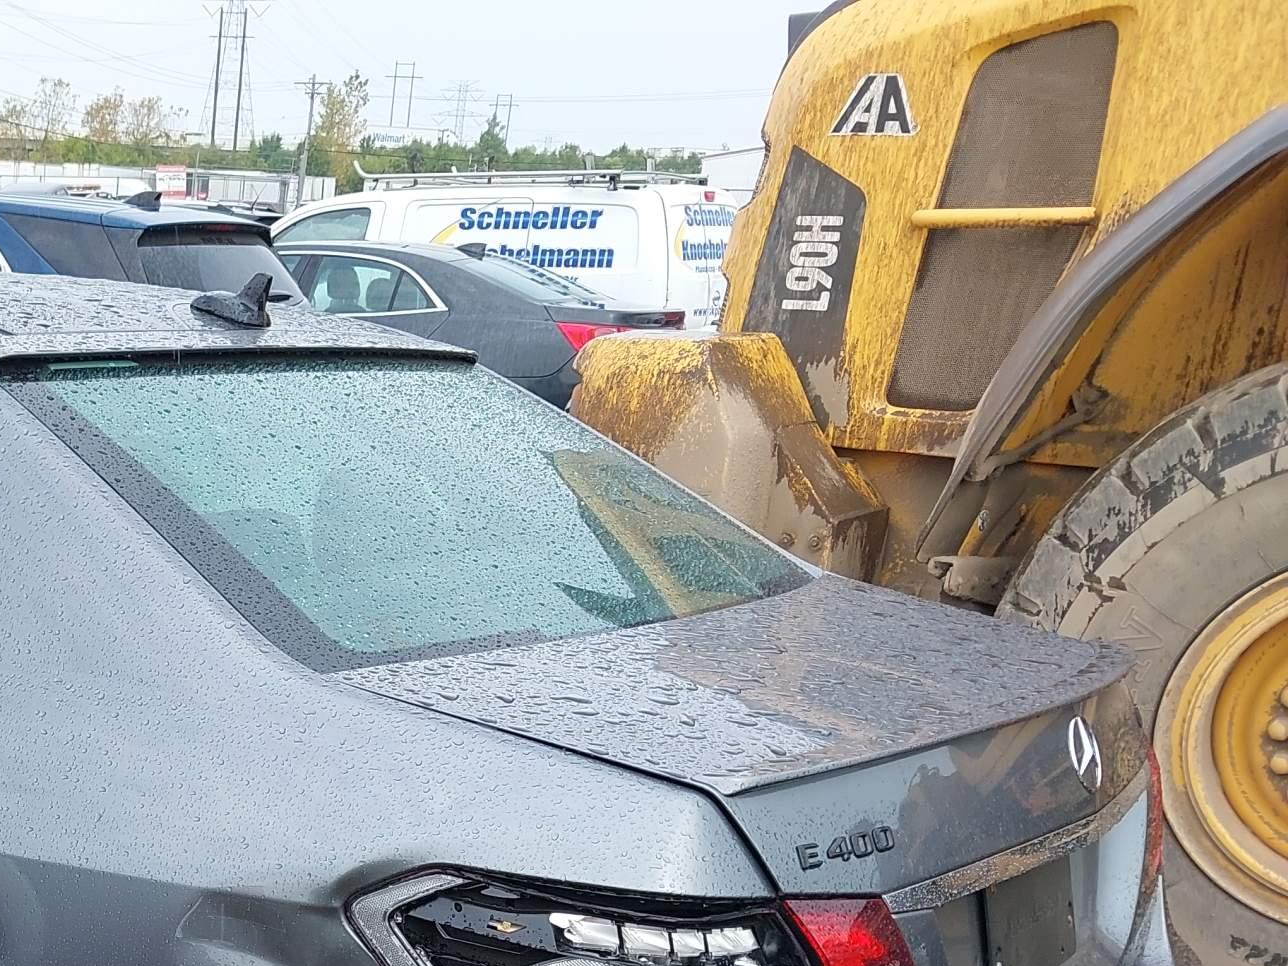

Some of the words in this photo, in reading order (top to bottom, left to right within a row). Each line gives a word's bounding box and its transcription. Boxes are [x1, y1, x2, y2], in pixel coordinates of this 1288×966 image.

[374, 132, 405, 143] Walmart
[459, 206, 604, 230] Schneller
[684, 206, 734, 226] Schnelle
[781, 215, 844, 312] L90H
[796, 843, 823, 871] E
[827, 826, 894, 862] 400
